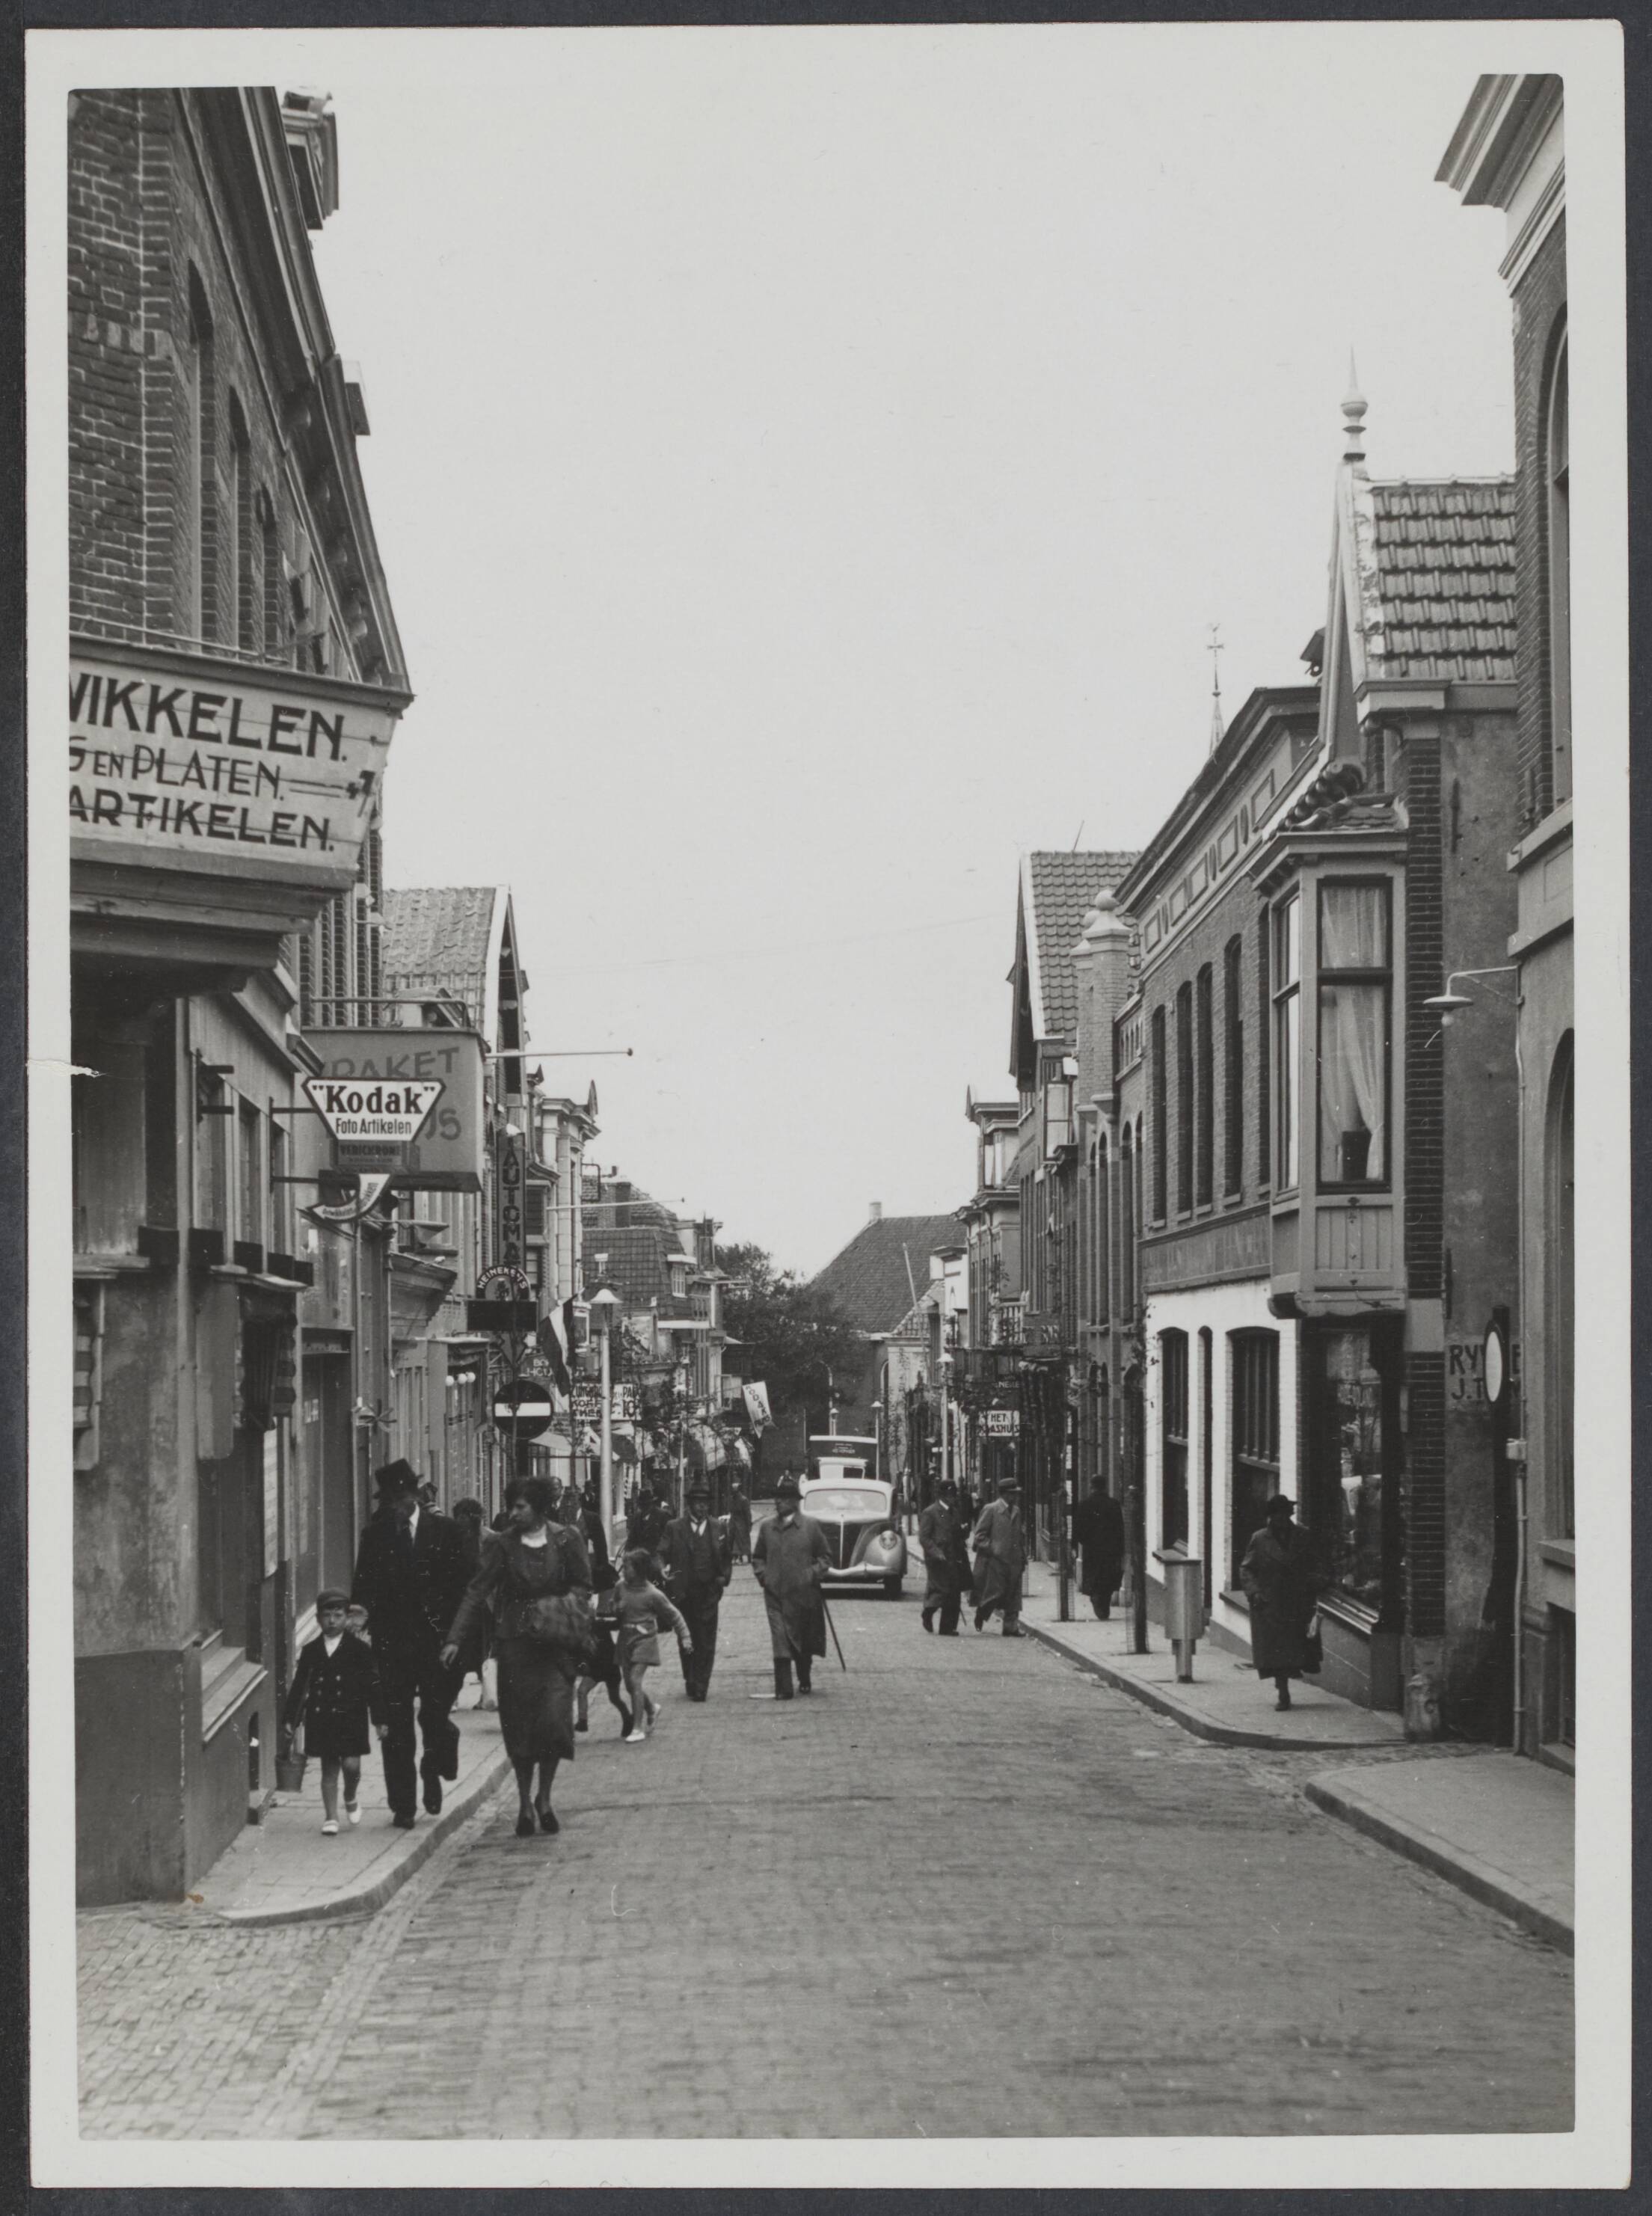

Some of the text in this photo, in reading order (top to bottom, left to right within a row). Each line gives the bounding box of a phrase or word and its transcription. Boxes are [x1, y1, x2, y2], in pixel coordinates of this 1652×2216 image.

[93, 749, 124, 779] EN
[131, 743, 285, 802] PLATEN.
[336, 1117, 412, 1135] Foto Artikelen
[990, 1413, 1007, 1422] HET
